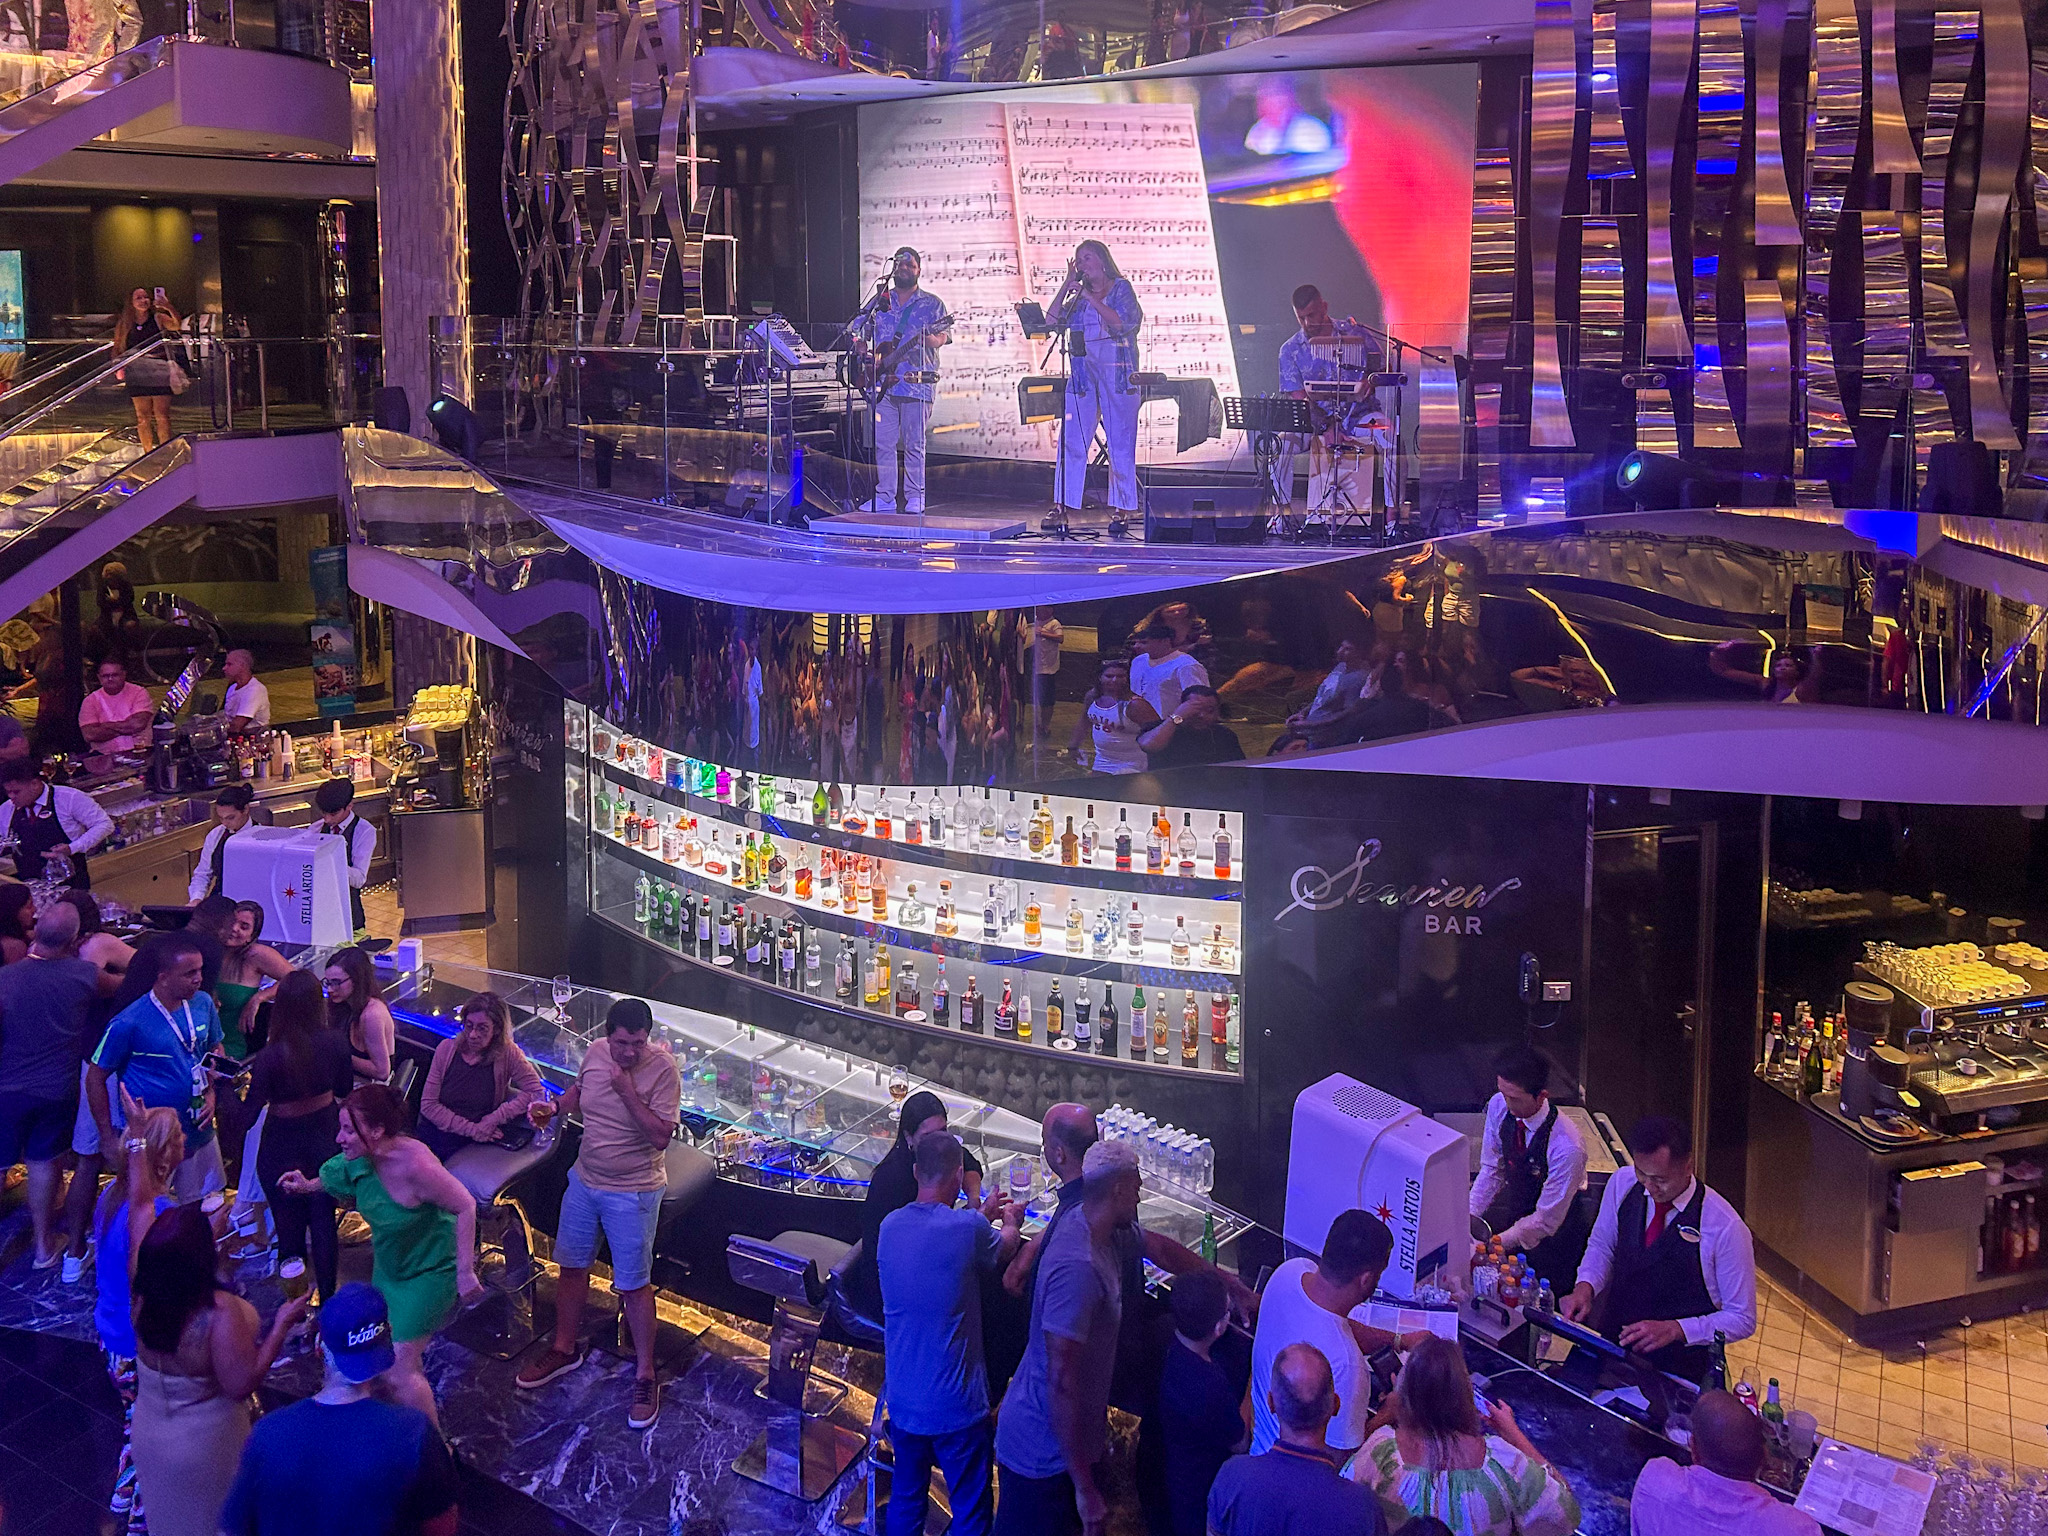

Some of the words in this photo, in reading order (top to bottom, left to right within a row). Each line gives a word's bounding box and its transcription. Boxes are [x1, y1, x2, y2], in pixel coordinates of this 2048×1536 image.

[520, 750, 541, 773] BAR
[302, 864, 313, 894] ARTOIS
[1273, 838, 1522, 929] Seaview
[301, 895, 312, 925] STELLA
[1425, 914, 1482, 935] BAR
[1402, 1177, 1421, 1228] ARTOIS
[1399, 1227, 1418, 1274] STELLA
